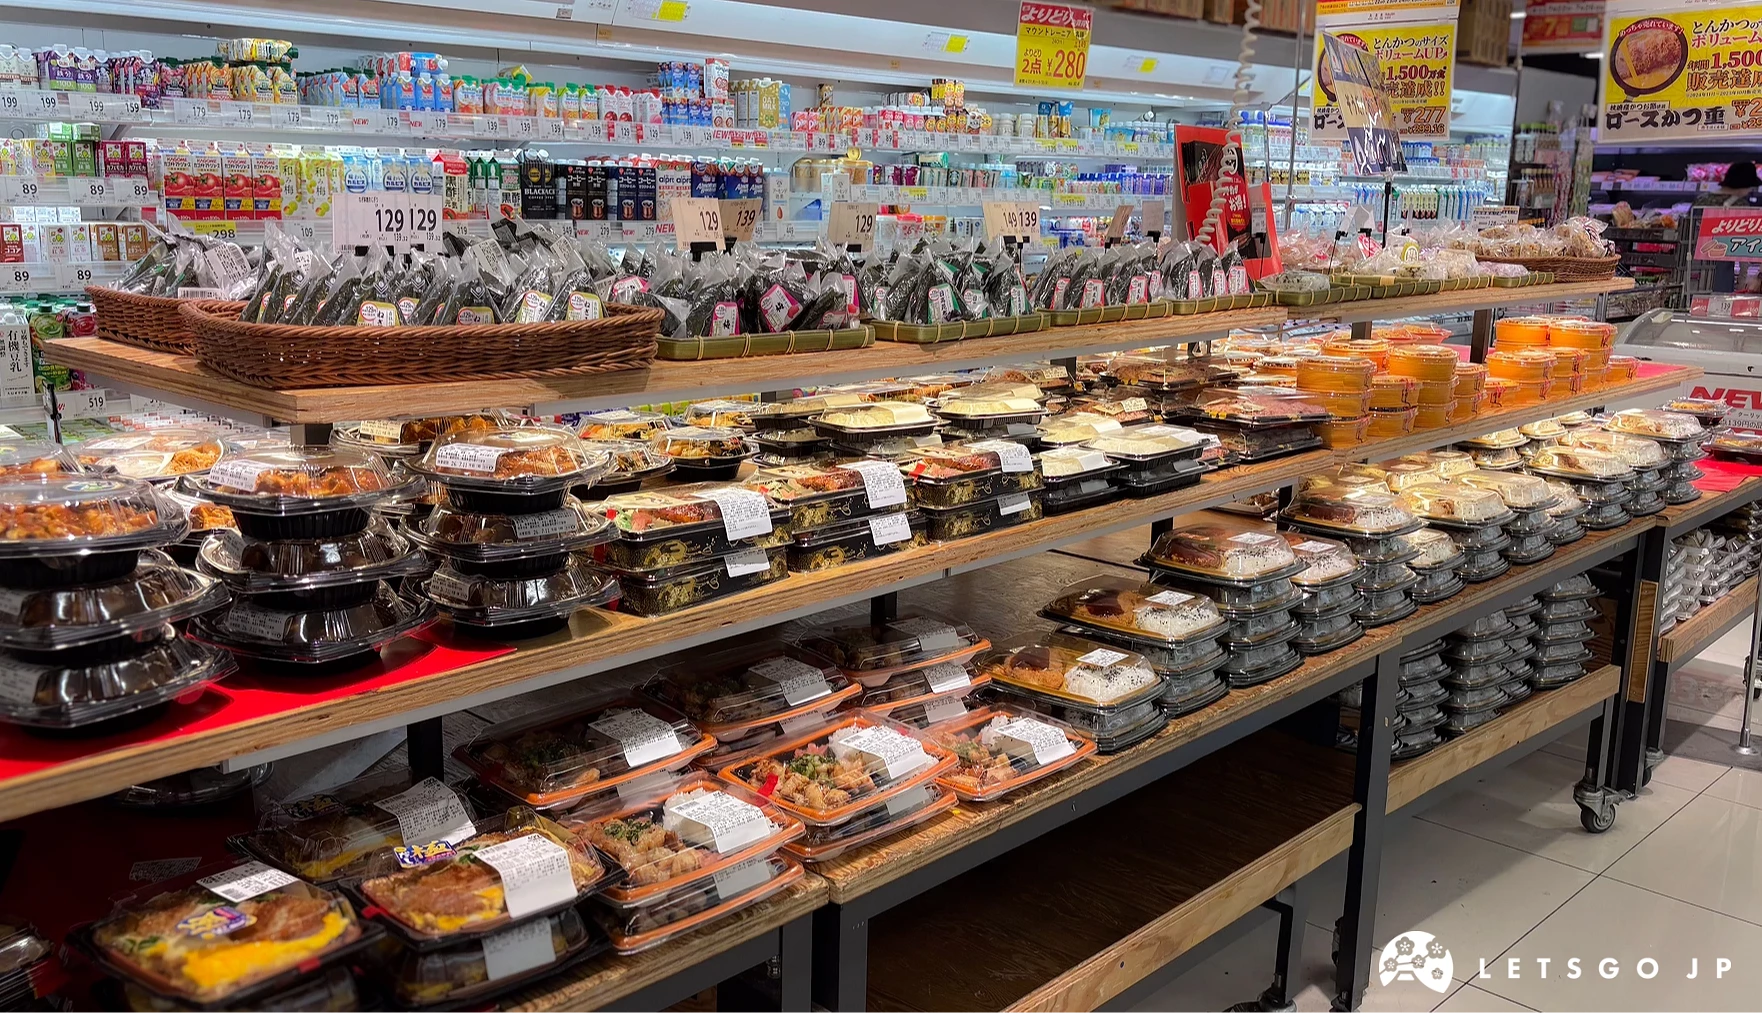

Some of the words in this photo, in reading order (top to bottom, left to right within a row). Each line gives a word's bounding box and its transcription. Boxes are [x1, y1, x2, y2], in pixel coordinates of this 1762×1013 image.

[1021, 6, 1074, 25] よりどり
[1025, 27, 1071, 38] マウントレーニア
[1374, 34, 1450, 49] とんかつのサイズ
[1024, 48, 1042, 57] よりどり
[1022, 58, 1042, 74] 2点
[2, 97, 17, 108] 199
[41, 97, 56, 108] 199
[762, 96, 776, 104] OAT
[89, 100, 104, 112] 199
[125, 102, 139, 113] 159
[192, 106, 206, 117] 179
[238, 109, 251, 120] 179
[287, 112, 300, 122] 179
[327, 114, 338, 124] 179
[1606, 106, 1726, 130] ロースかつ重
[387, 116, 398, 126] 179
[435, 119, 446, 128] 179
[487, 120, 497, 131] 139
[520, 122, 530, 132] 139
[551, 124, 561, 133] 139
[592, 125, 601, 135] 139
[621, 127, 630, 136] 129
[649, 129, 658, 138] 129
[22, 184, 38, 194] 89
[90, 185, 104, 195] 89
[134, 185, 148, 196] 89
[376, 209, 404, 232] 129
[410, 208, 436, 231] 129
[700, 210, 719, 231] 129
[736, 210, 756, 227] 139
[855, 214, 873, 233] 129
[1003, 211, 1017, 228] 149
[1019, 211, 1037, 227] 139
[301, 227, 313, 238] 109
[457, 226, 468, 235] 219
[600, 226, 610, 236] 279
[646, 227, 654, 236] 279
[1730, 238, 1762, 253] アイ
[14, 271, 29, 282] 89
[77, 269, 92, 280] 89
[1721, 302, 1731, 311] 139
[8, 330, 22, 373] 有機豆乳
[89, 397, 104, 408] 519
